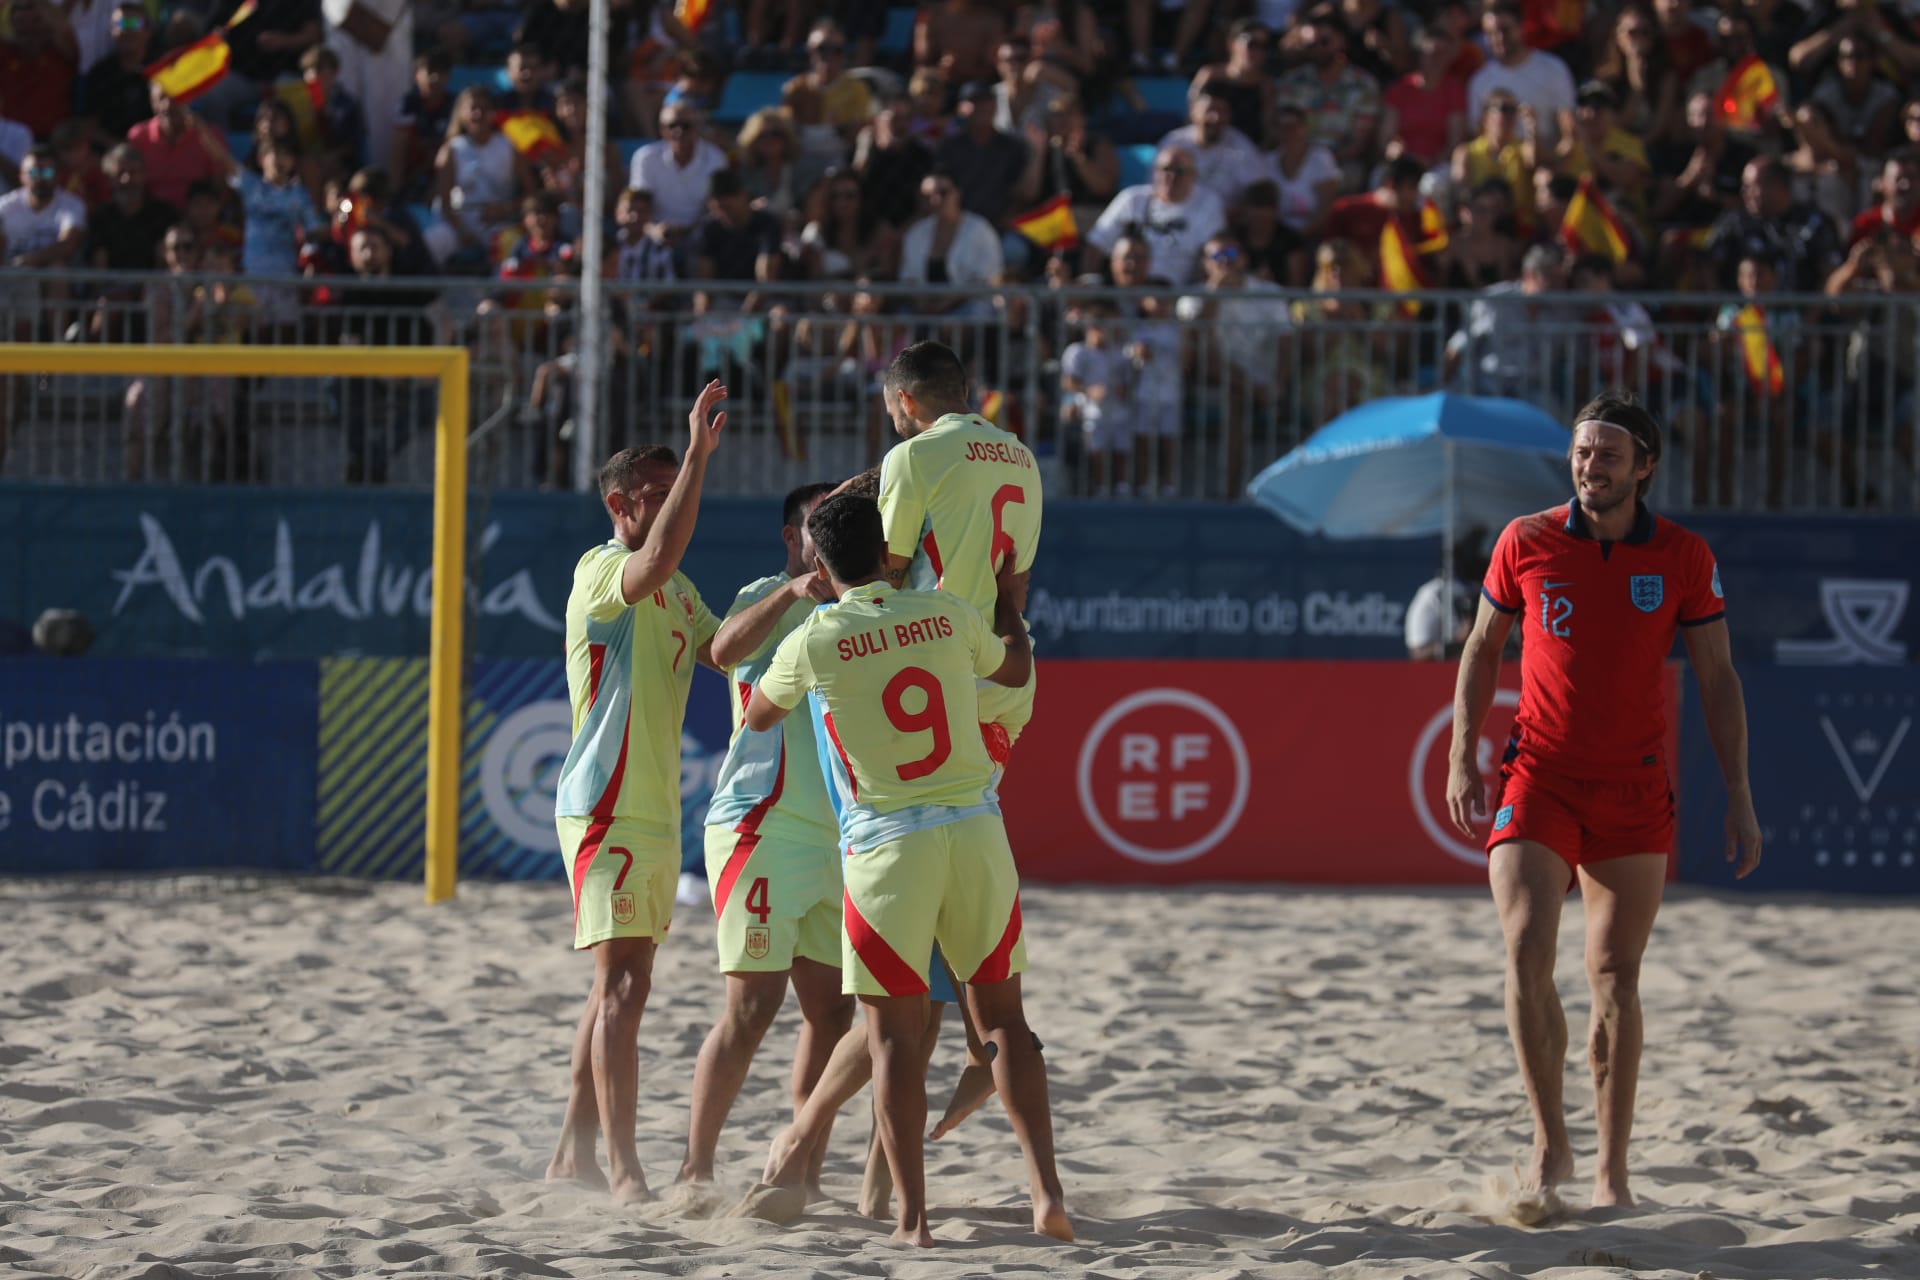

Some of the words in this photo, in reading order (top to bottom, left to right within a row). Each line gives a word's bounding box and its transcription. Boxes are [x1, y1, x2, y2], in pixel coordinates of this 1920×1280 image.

[964, 441, 1031, 469] JOSELITO
[990, 483, 1025, 575] 6
[1027, 588, 1250, 638] Ayuntamiento
[1254, 592, 1297, 634] de
[1303, 591, 1403, 635] Cádiz
[1540, 592, 1574, 637] 12
[671, 630, 687, 674] 7
[837, 628, 888, 661] SULI
[895, 615, 953, 648] BATIS
[0, 709, 216, 769] putación
[881, 666, 952, 781] 9
[32, 779, 168, 832] Cádiz
[607, 846, 634, 891] 7
[744, 876, 772, 925] 4
